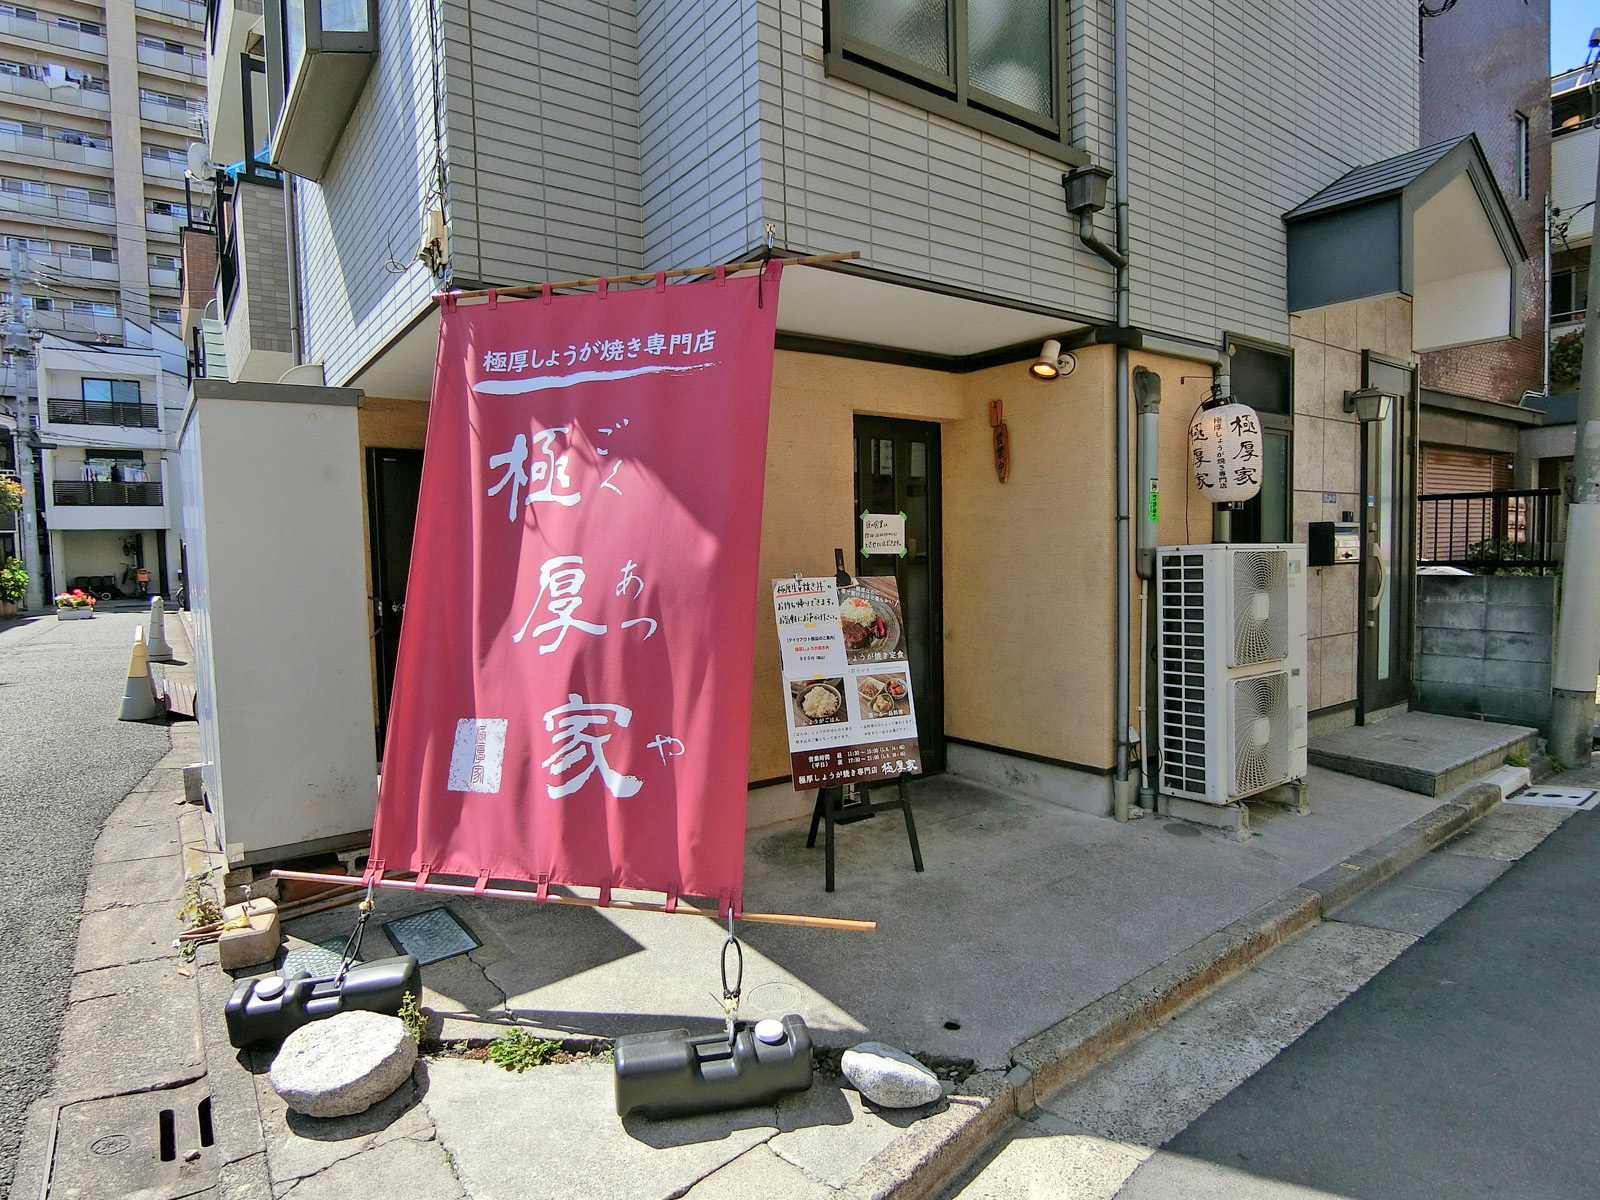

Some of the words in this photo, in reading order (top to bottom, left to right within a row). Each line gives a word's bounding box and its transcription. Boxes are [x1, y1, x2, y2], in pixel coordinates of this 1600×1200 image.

[483, 329, 717, 373] 極厚しょうが焼き専門店
[596, 418, 630, 496] ごく
[1189, 422, 1215, 490] 極厚家
[1230, 414, 1259, 486] 極厚家
[487, 427, 645, 800] 極厚家
[615, 560, 658, 640] あつ
[646, 734, 685, 767] や
[798, 766, 878, 784] 極厚しょうが焼き専門店
[881, 758, 918, 775] 極厚家
